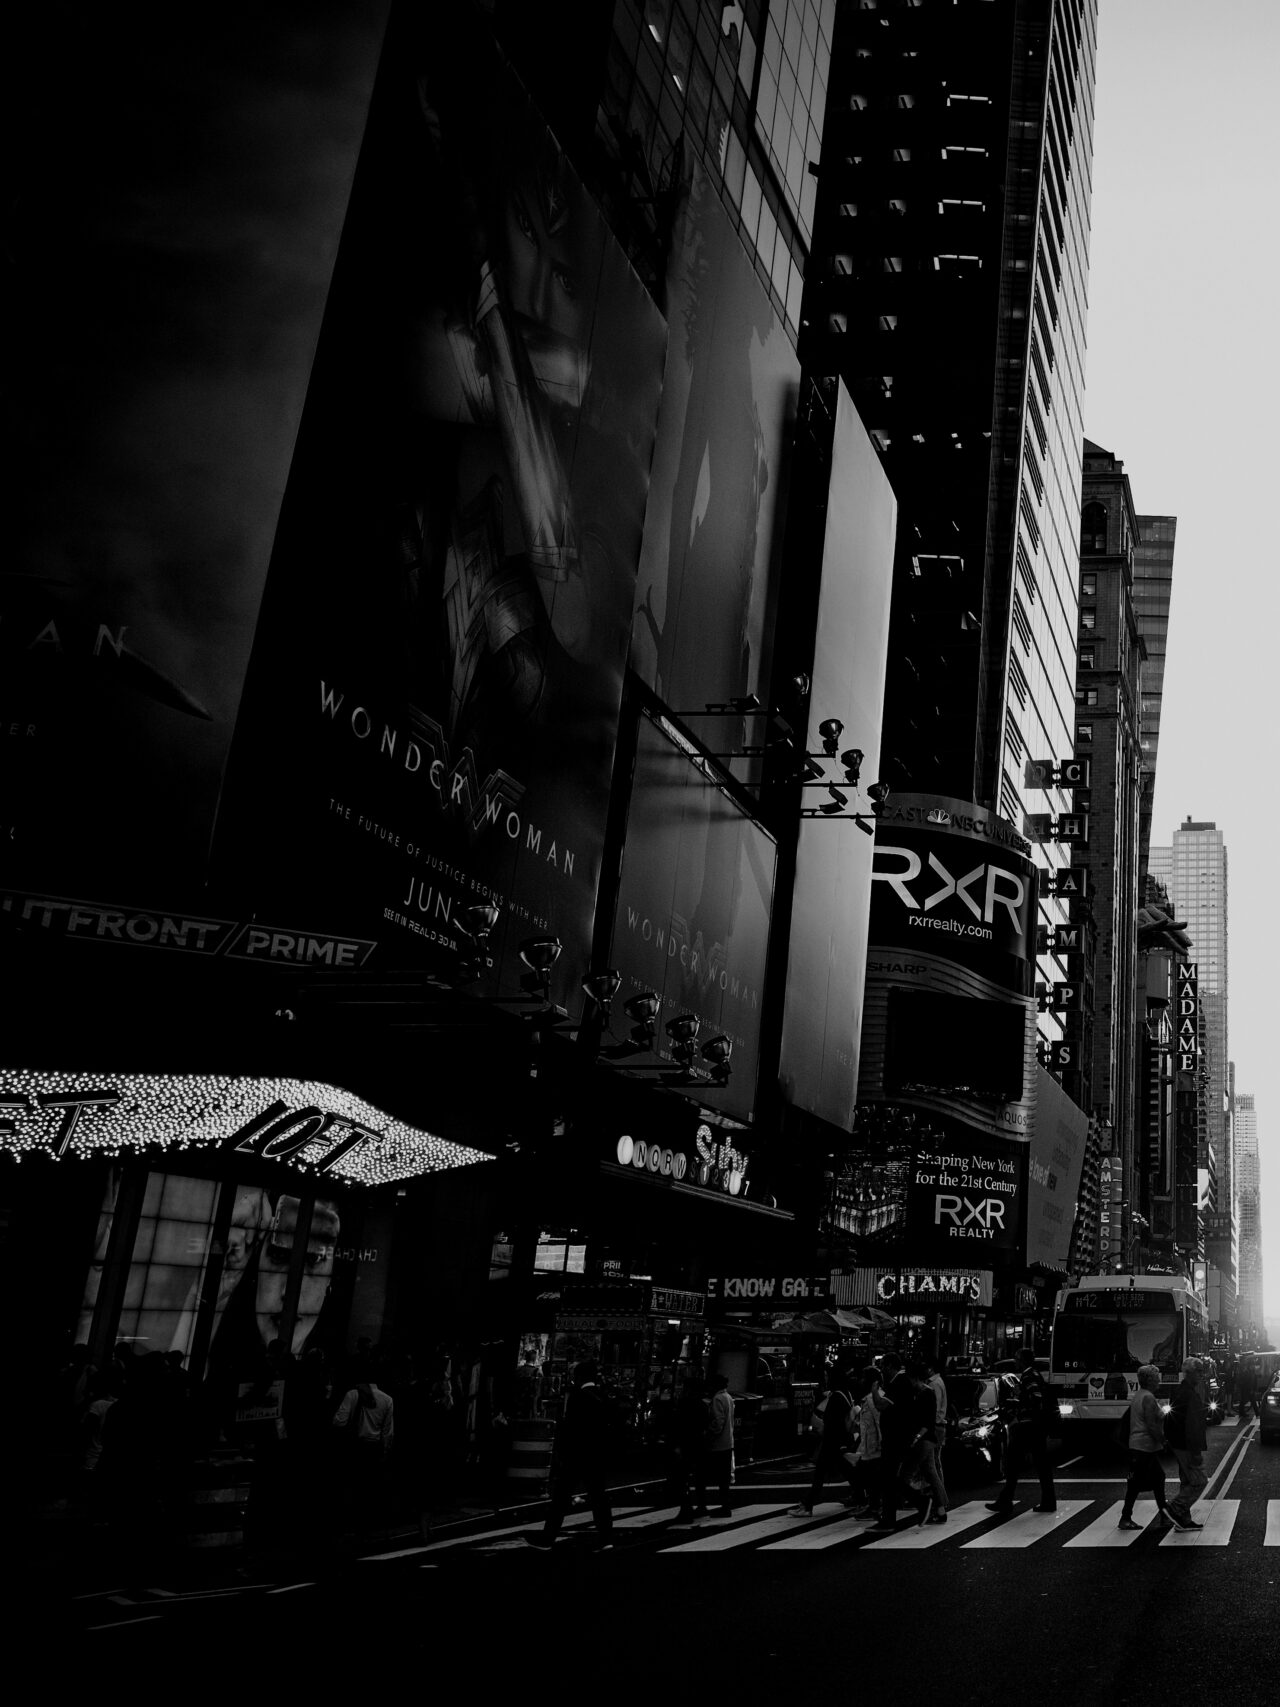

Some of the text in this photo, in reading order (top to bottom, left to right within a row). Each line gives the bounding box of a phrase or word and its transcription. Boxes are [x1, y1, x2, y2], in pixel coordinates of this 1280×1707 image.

[0, 608, 128, 659] AN
[0, 720, 39, 736] ER
[320, 679, 575, 877] WONDER WOMAN
[328, 798, 351, 821] THE
[357, 815, 400, 848] FUTURE
[405, 843, 421, 857] OF
[426, 853, 466, 886] JUSTICE
[470, 878, 504, 907] BEGINS
[403, 876, 453, 923] JUN
[872, 845, 1023, 936] RXR
[1, 895, 359, 967] TFRONT PRIME
[908, 914, 993, 940] rxrrealty.com
[627, 906, 758, 1009] WONDER WOMAN
[866, 961, 928, 975] SHARP
[1178, 963, 1197, 1071] MADAME
[997, 1110, 1028, 1127] AQUOS
[917, 1150, 969, 1172] Shaping
[972, 1155, 996, 1171] New
[997, 1158, 1016, 1175] York
[915, 1169, 1018, 1198] for the 21st Century
[934, 1193, 1006, 1230] RXR
[949, 1226, 995, 1239] REALTY
[723, 1277, 776, 1298] KNOW
[876, 1274, 981, 1300] CHAMPS
